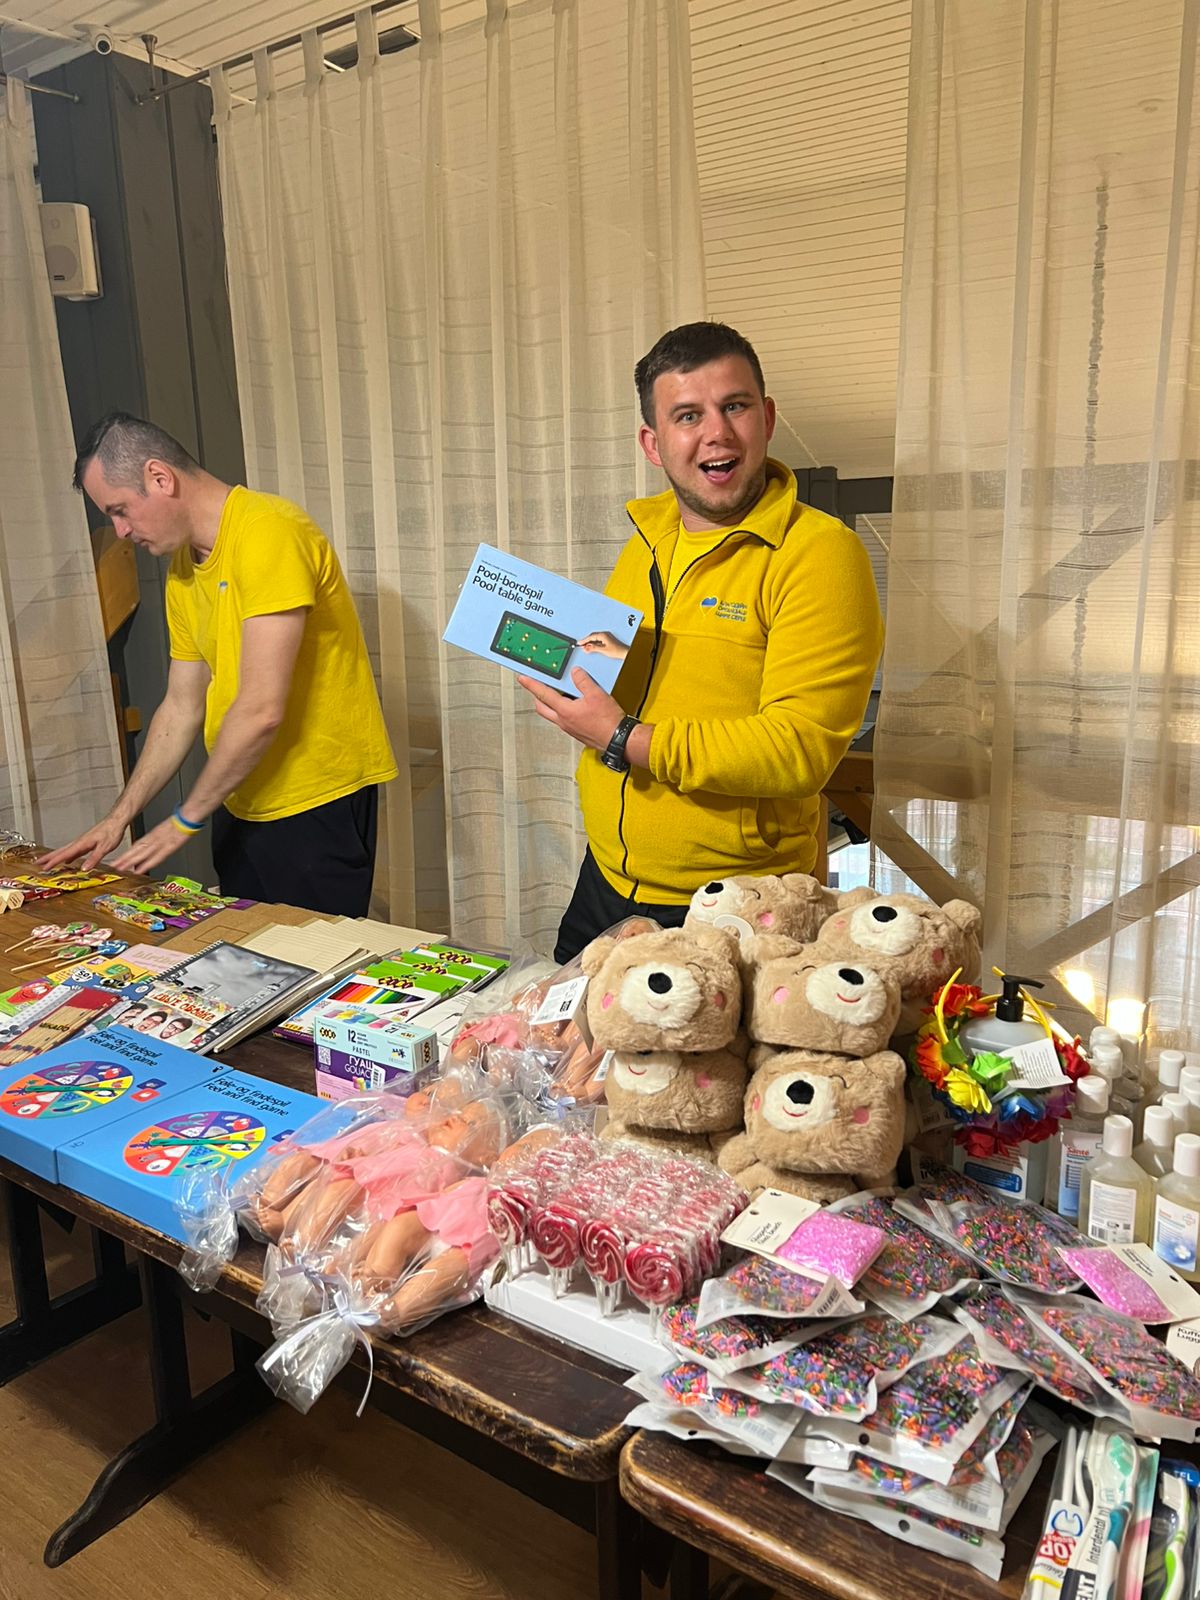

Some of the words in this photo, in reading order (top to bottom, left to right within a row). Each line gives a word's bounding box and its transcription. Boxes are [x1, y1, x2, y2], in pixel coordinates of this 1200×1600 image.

[477, 565, 543, 600] Pool-bordspil
[472, 575, 497, 592] Pool
[497, 587, 523, 604] table
[524, 600, 554, 617] game
[347, 1029, 356, 1043] 12
[130, 1055, 158, 1067] game
[349, 1055, 373, 1070] ГУАШ
[344, 1063, 372, 1078] GOUAC
[257, 1104, 289, 1117] game
